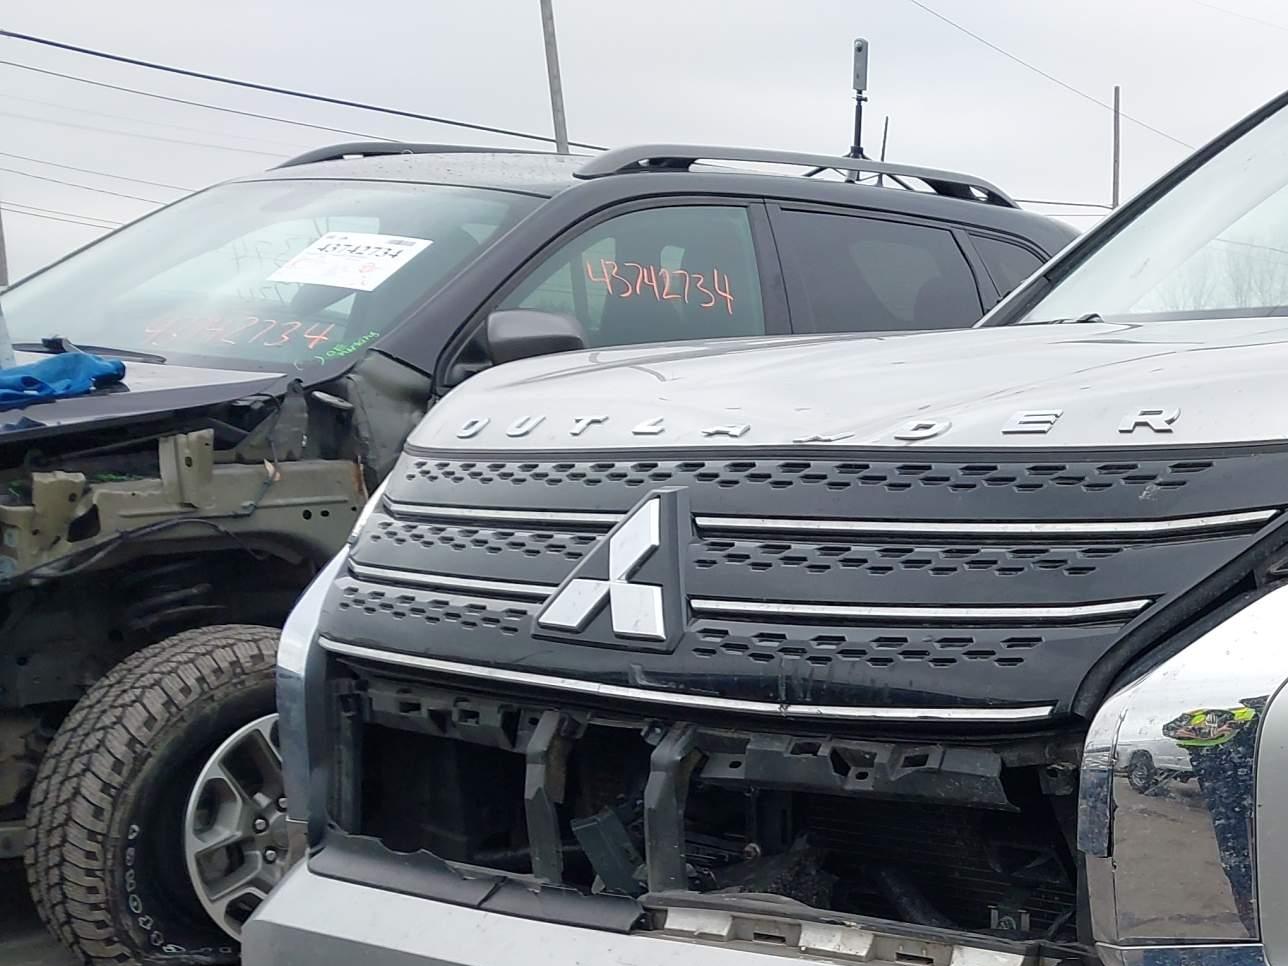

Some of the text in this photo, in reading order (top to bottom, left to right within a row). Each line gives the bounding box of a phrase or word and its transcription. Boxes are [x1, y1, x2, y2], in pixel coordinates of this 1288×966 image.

[317, 243, 404, 259] 43742734
[586, 258, 735, 316] 43742734
[145, 316, 336, 349] 442734
[455, 407, 1182, 443] OUTLANDER
